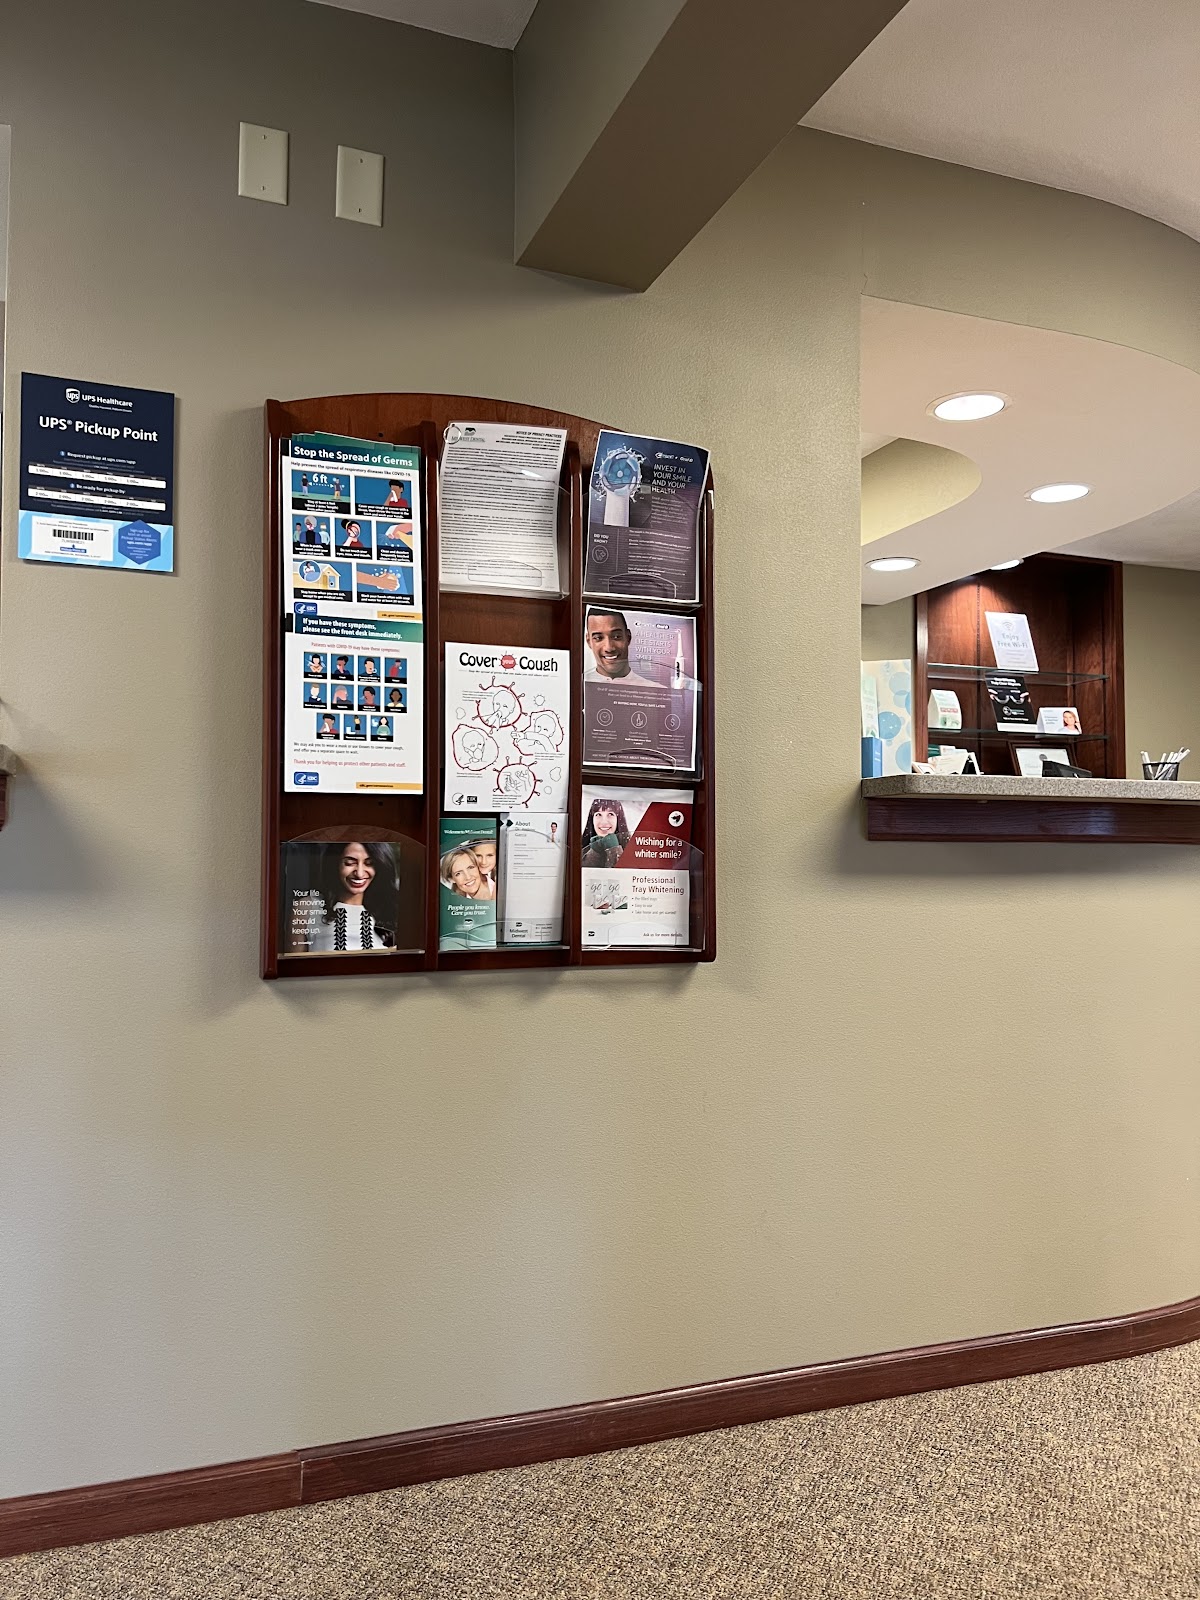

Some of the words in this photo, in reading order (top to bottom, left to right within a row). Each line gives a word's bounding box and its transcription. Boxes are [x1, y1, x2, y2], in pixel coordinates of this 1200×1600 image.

[82, 394, 96, 402] UPS
[97, 396, 133, 408] Healthcare
[75, 420, 120, 440] Pickup
[123, 427, 158, 442] Point
[294, 446, 317, 459] Stop
[318, 449, 334, 459] the
[336, 450, 370, 462] Spread
[371, 454, 382, 463] of
[383, 456, 413, 466] Germs
[653, 463, 677, 472] INVEST
[312, 473, 318, 483] 6
[320, 474, 328, 484] ft
[653, 471, 672, 480] YOUR
[672, 474, 692, 483] SMILE
[652, 479, 667, 487] AND
[667, 481, 686, 489] YOUR
[652, 486, 676, 494] HEALTH
[333, 620, 347, 628] these
[348, 622, 376, 630] symptoms,
[303, 626, 320, 634] please
[332, 627, 340, 635] the
[368, 630, 402, 640] immediately.
[1001, 633, 1019, 641] Enjoy
[650, 640, 672, 648] STARTS
[997, 640, 1011, 648] Free
[636, 646, 653, 654] WITH
[459, 652, 498, 668] Cover
[519, 656, 558, 672] Cough
[635, 836, 664, 848] Wishing
[666, 837, 676, 847] for
[634, 849, 658, 858] whiter
[658, 850, 682, 859] smile?
[632, 876, 676, 884] Professional
[310, 889, 320, 897] life
[632, 885, 646, 894] Tray
[648, 886, 685, 896] Whitening
[300, 899, 326, 908] moving.
[447, 904, 464, 912] People
[292, 908, 309, 916] Your
[309, 908, 328, 916] smile
[292, 917, 316, 925] should
[292, 927, 310, 935] keep
